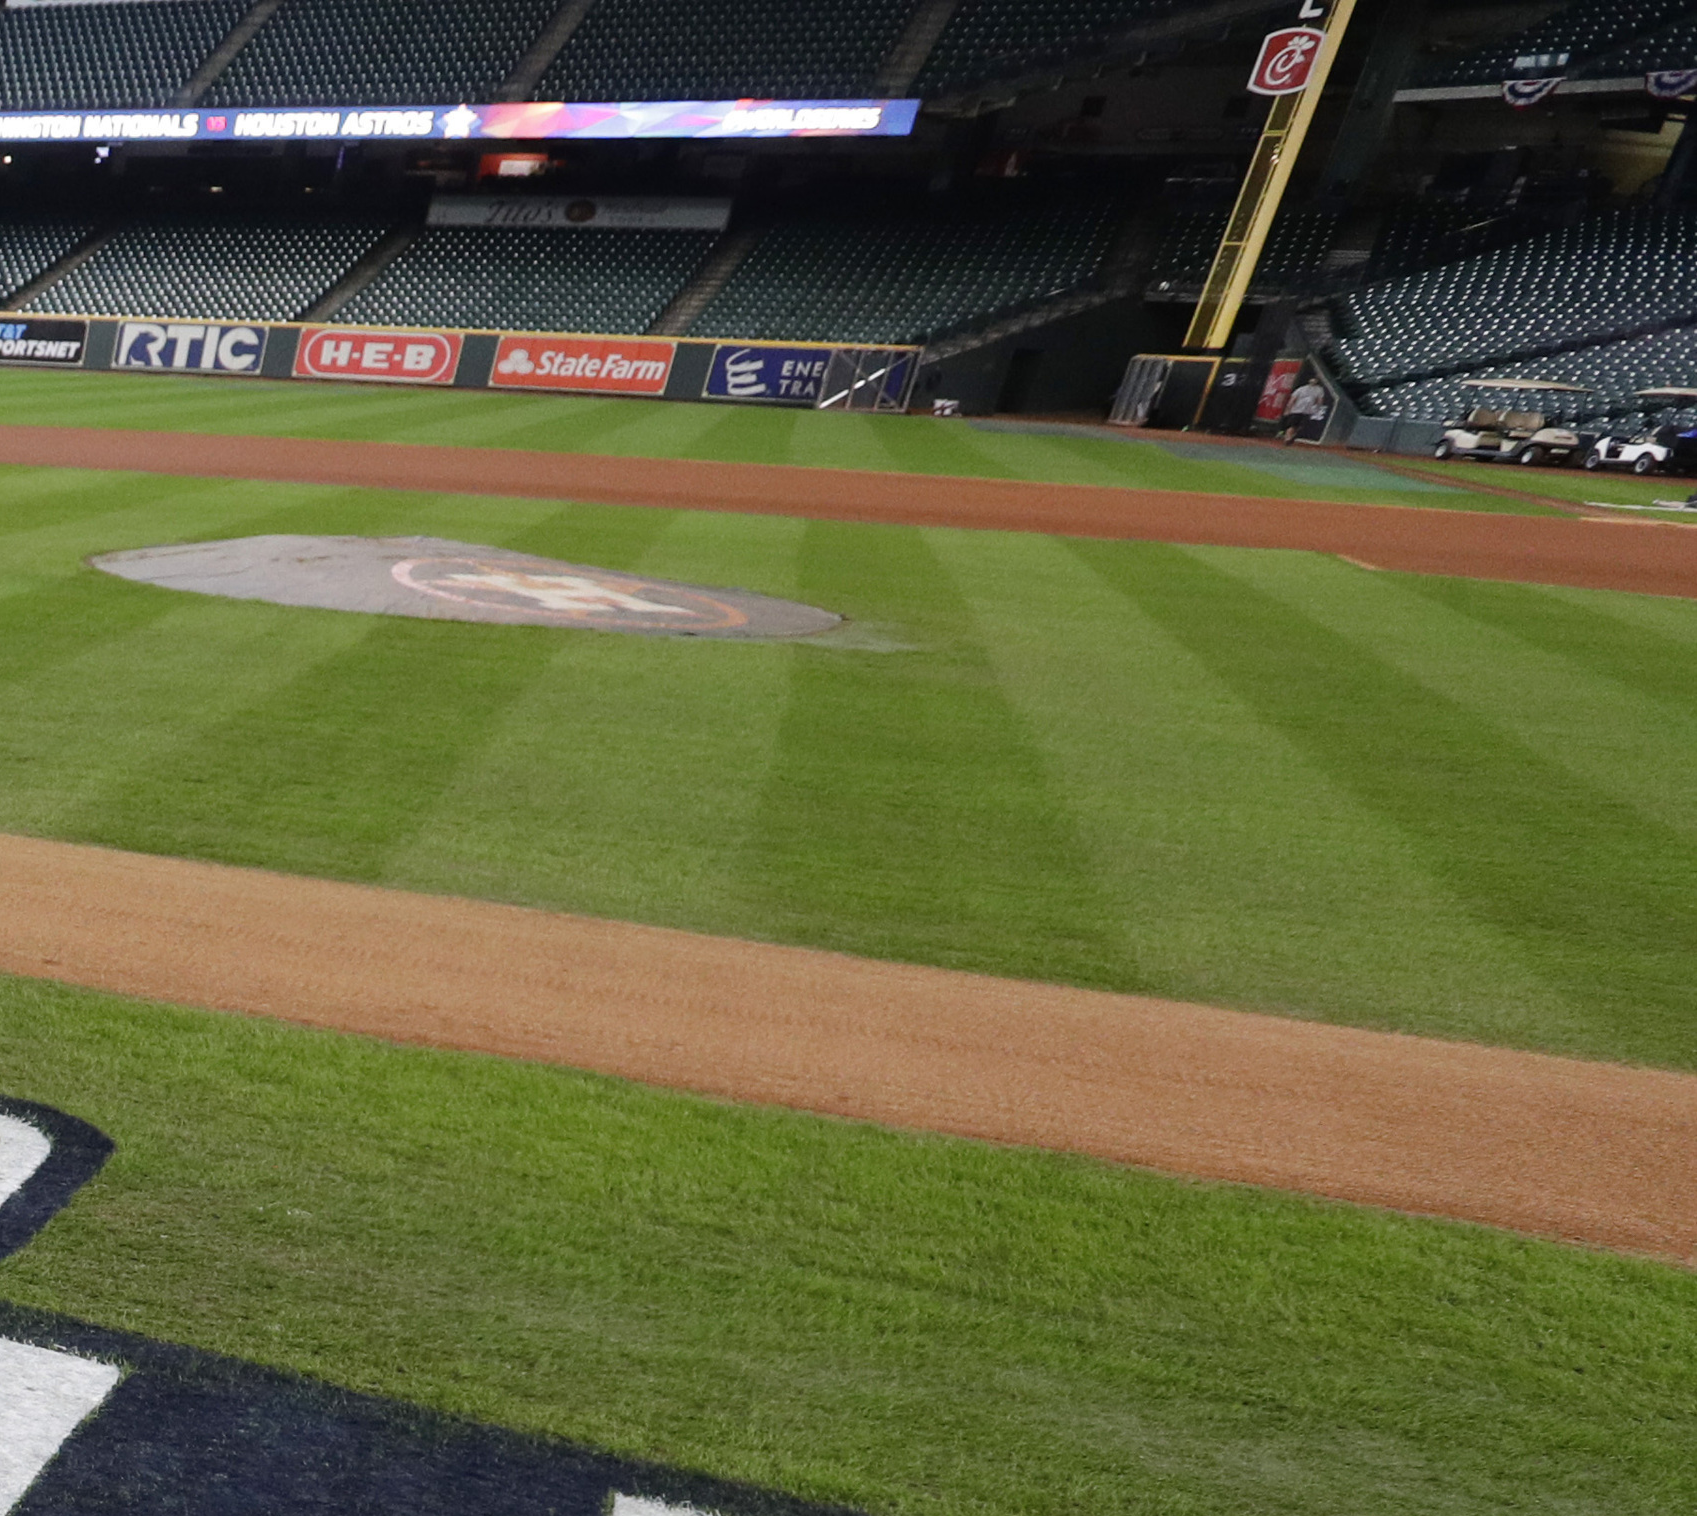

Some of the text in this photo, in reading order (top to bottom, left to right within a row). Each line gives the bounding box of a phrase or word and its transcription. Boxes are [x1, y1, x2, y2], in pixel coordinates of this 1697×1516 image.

[83, 113, 199, 137] NATIONALS
[233, 111, 435, 137] HOUSTON ASTROS
[118, 322, 261, 371] RTIC
